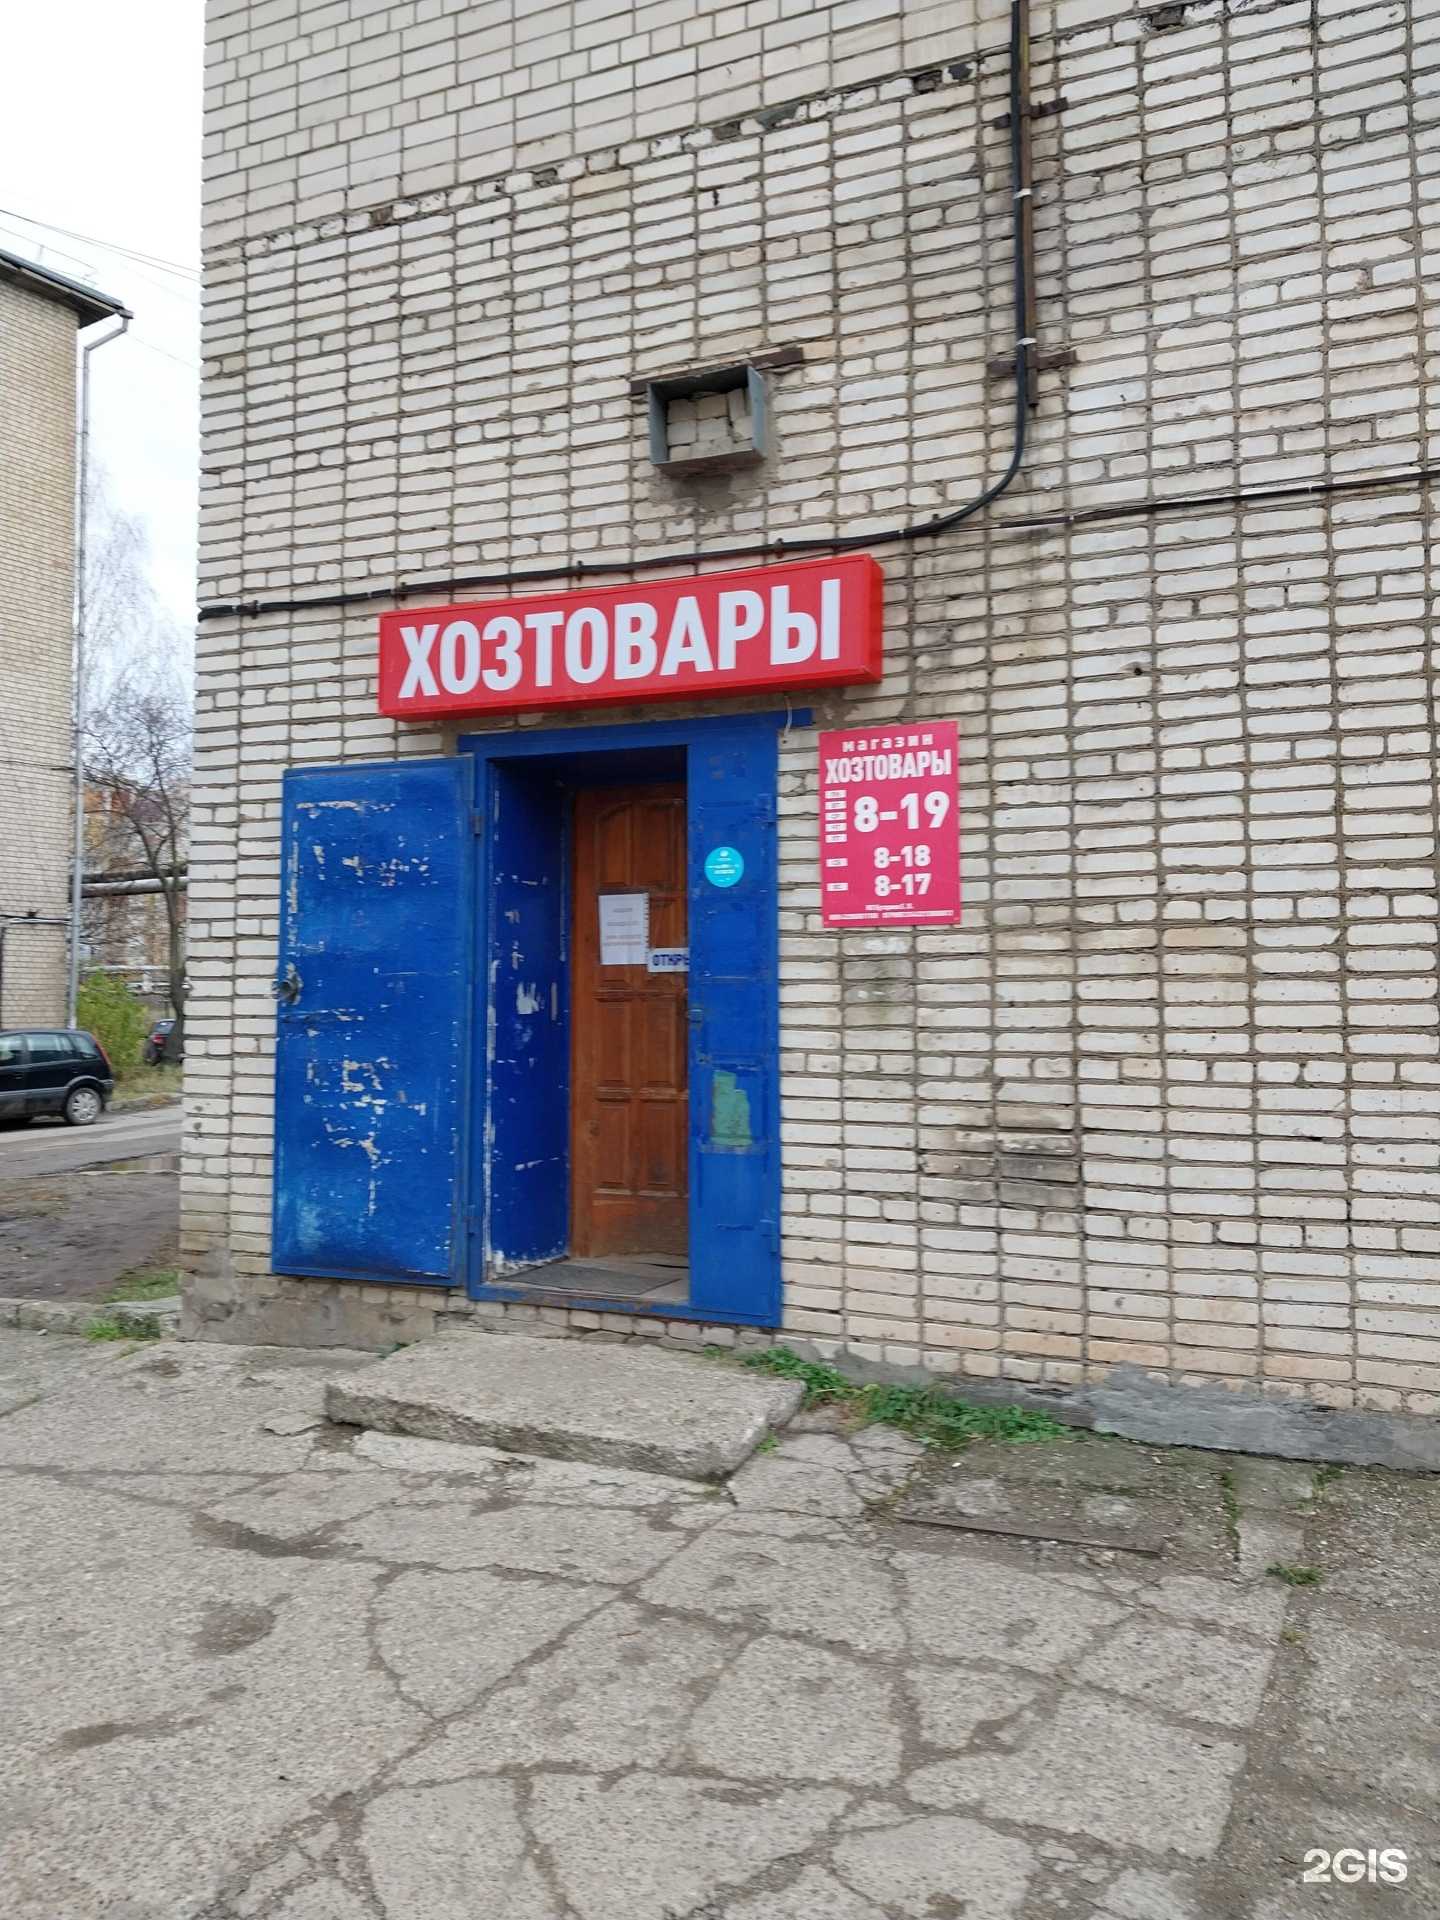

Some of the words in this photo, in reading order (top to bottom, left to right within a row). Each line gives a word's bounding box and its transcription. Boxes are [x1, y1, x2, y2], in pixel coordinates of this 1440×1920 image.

[398, 578, 842, 699] ХОЗТОВАРЫ
[842, 733, 934, 753] магазин
[825, 748, 952, 784] ХОЗТОВАРЫ
[853, 790, 950, 833] 8-19
[873, 844, 931, 869] 8-18
[874, 872, 932, 897] 8-17
